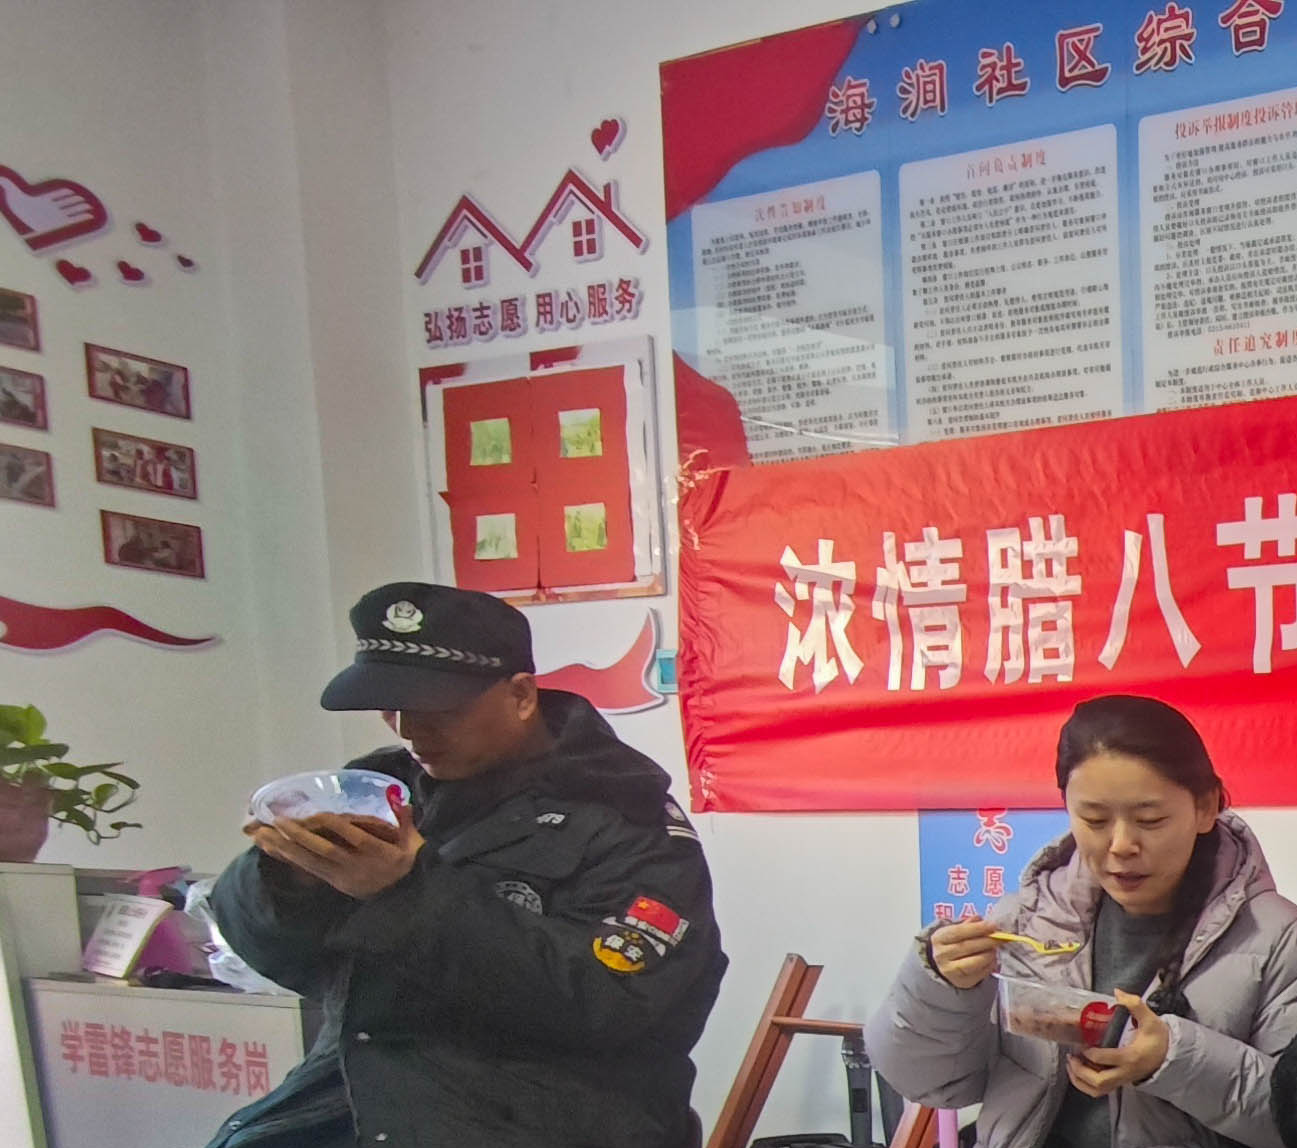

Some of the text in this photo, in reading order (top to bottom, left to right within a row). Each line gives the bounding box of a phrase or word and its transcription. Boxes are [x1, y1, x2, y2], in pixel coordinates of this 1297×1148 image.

[423, 277, 638, 344] 弘扬志愿 用心服务
[61, 1020, 271, 1097] 学雷锋志愿服务岗
